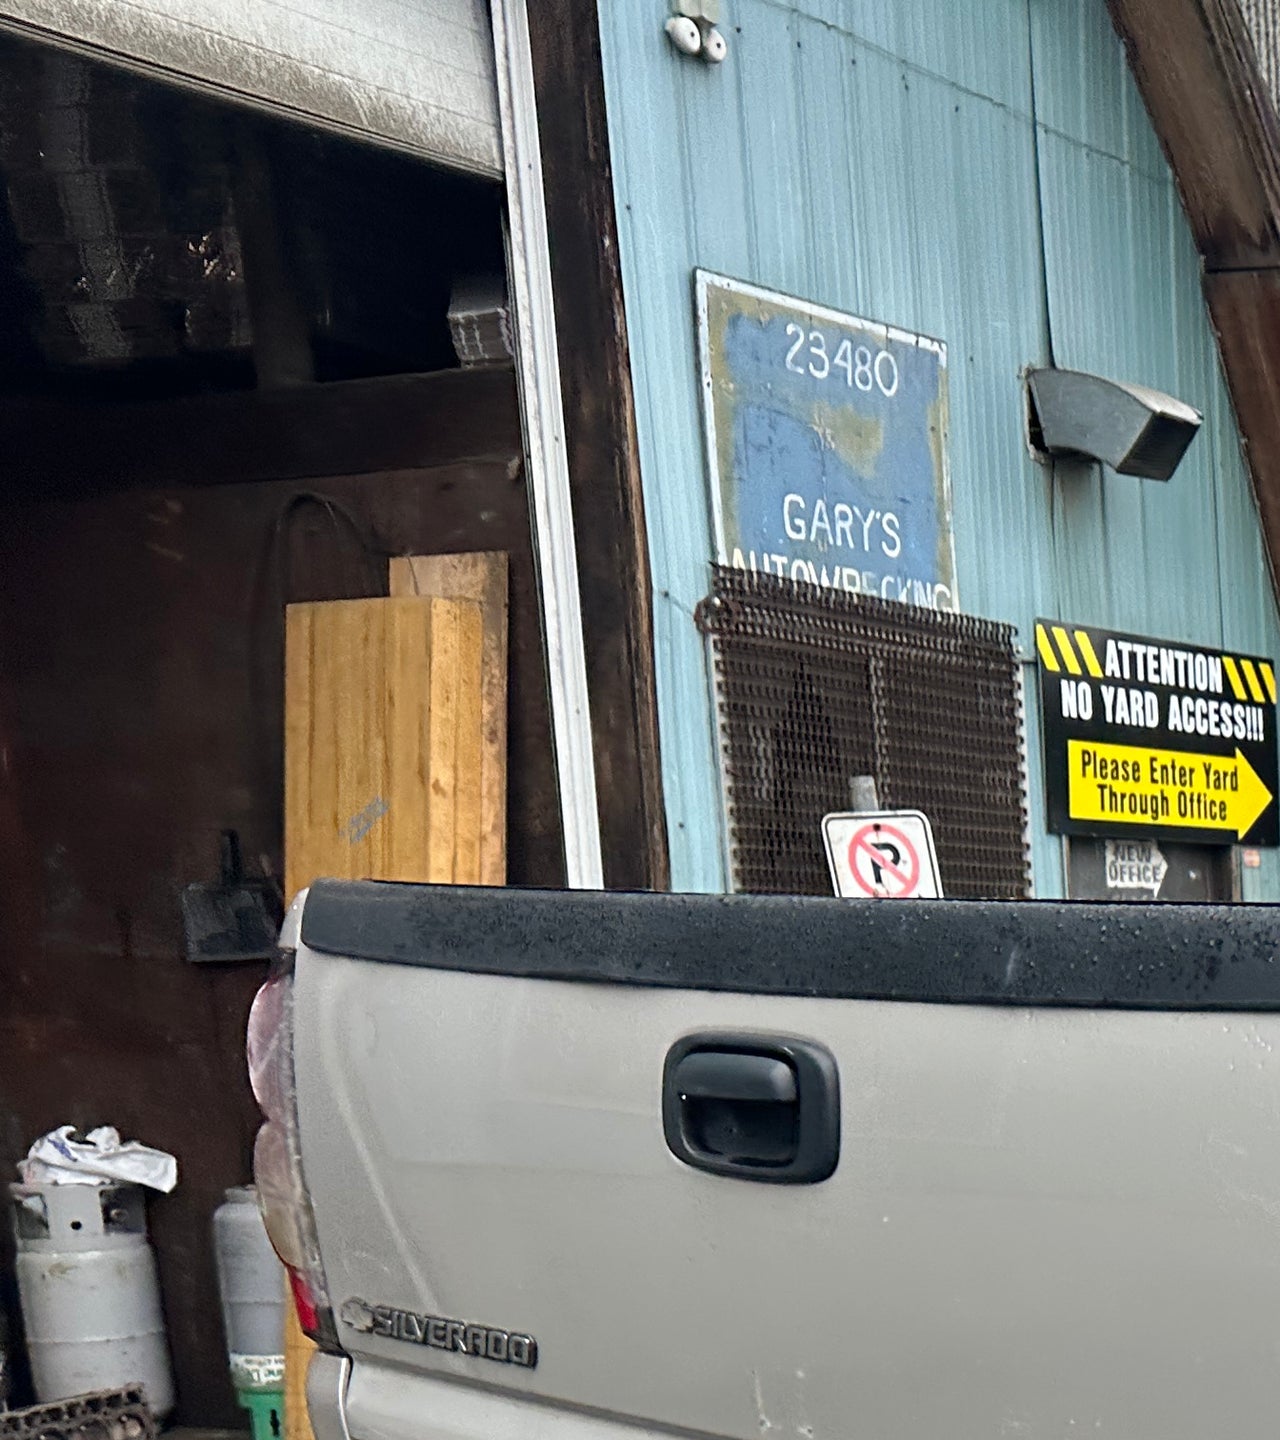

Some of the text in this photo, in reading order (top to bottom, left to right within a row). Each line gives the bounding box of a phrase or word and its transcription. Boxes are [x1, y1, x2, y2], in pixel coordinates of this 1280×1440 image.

[785, 323, 898, 397] 23480
[783, 494, 900, 558] GARY'S
[1105, 639, 1223, 693] ATTENTION
[1060, 679, 1264, 741] NO YARD ACCESS!!!
[1081, 749, 1239, 792] Please Enter Yard
[1097, 783, 1227, 821] Through Office
[1109, 860, 1161, 883] OFFICE
[373, 1304, 539, 1369] SILVERADO
